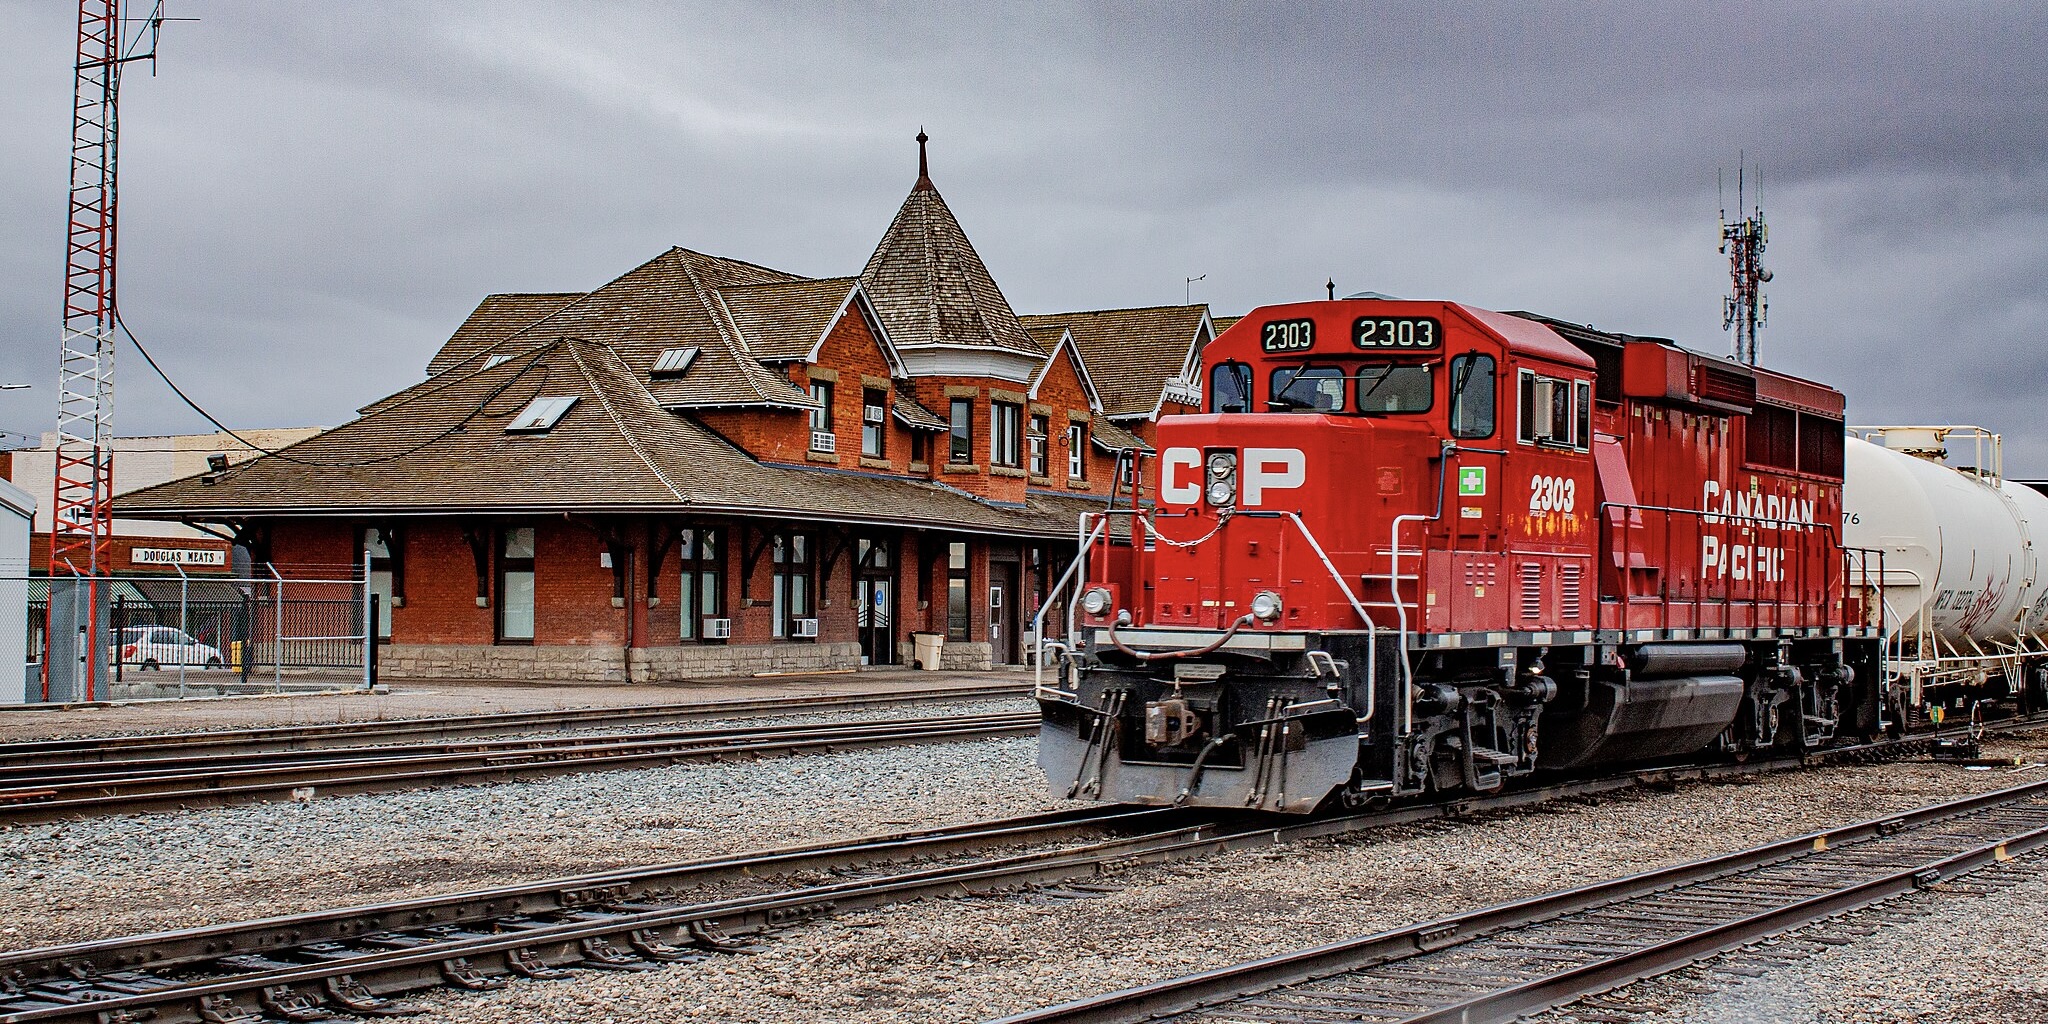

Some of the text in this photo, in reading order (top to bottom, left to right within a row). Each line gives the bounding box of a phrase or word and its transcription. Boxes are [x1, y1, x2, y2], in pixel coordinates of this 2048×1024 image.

[1266, 321, 1311, 350] 2303
[1360, 320, 1433, 346] 2303
[1529, 474, 1575, 513] 2303
[1703, 479, 1814, 534] CANADIAN
[143, 550, 215, 563] DOUGLAS MEATS
[1701, 534, 1785, 582] PACIFIC
